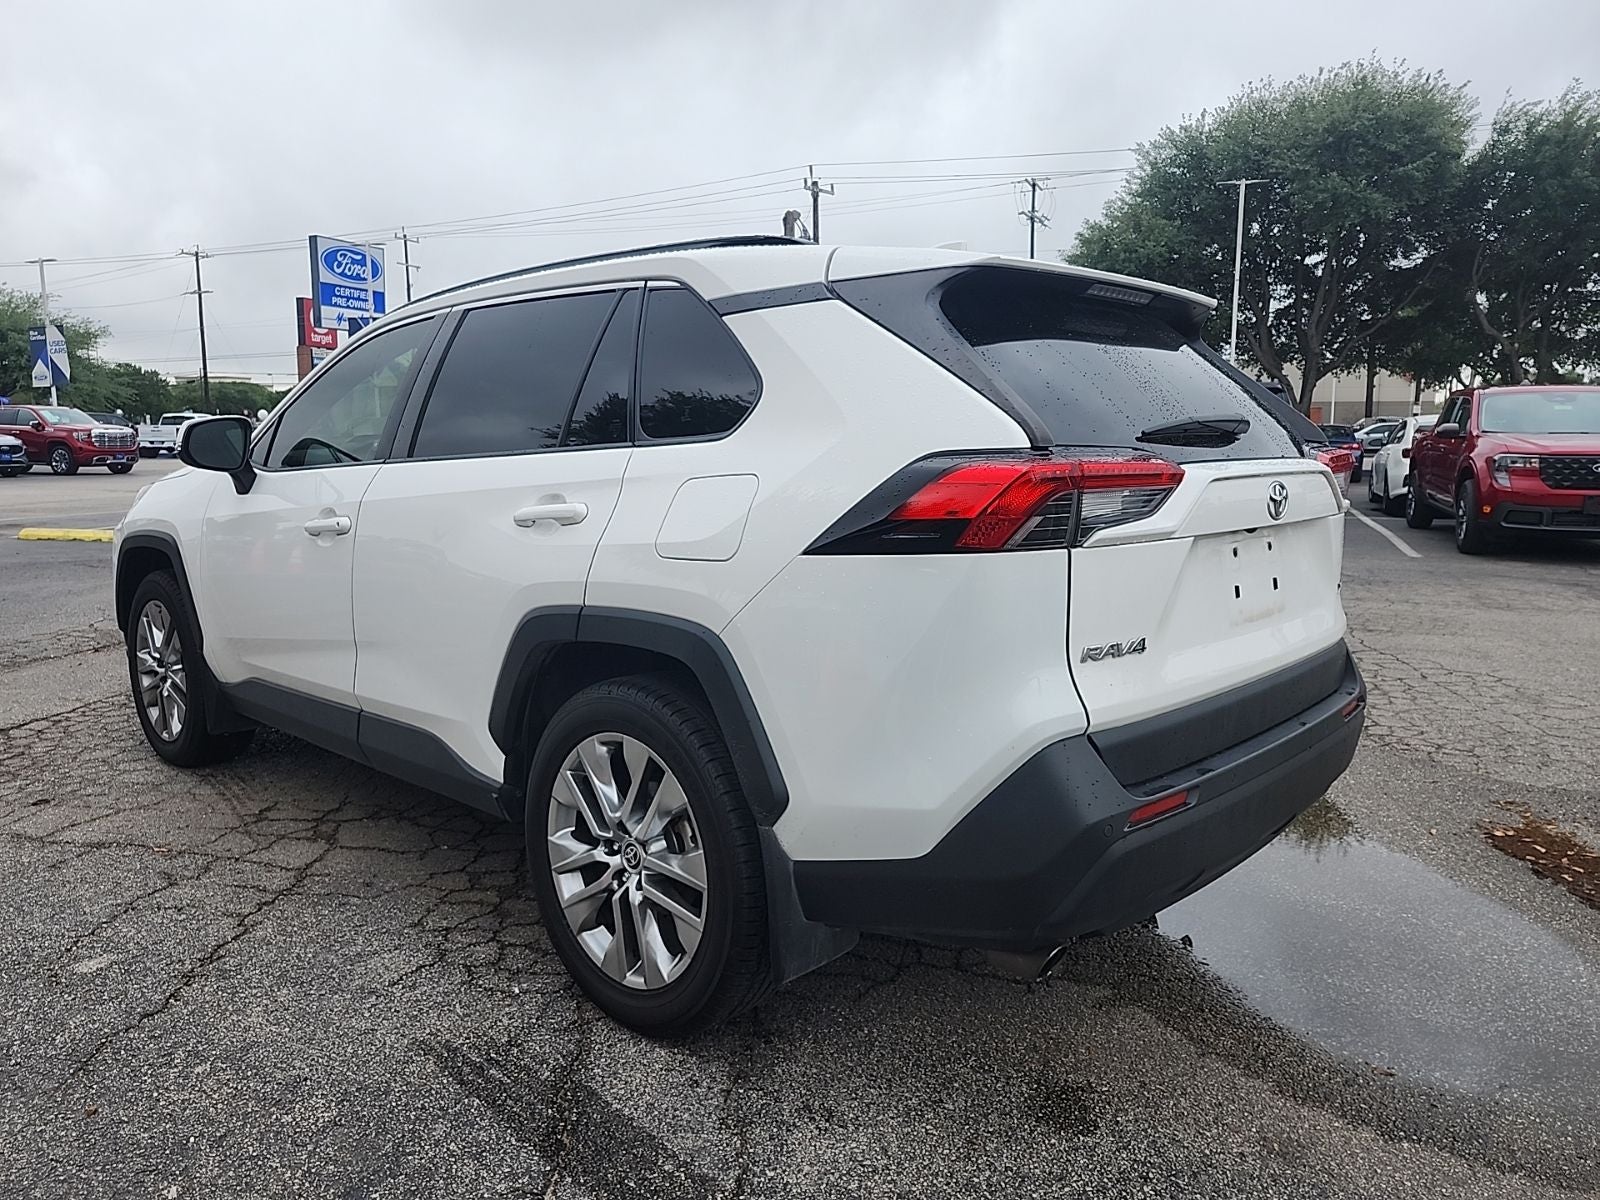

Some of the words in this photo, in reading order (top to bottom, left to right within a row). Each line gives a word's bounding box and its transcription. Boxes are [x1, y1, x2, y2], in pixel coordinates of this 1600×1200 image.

[49, 339, 66, 347] USED
[311, 332, 333, 345] target
[1080, 635, 1147, 663] RAV4
